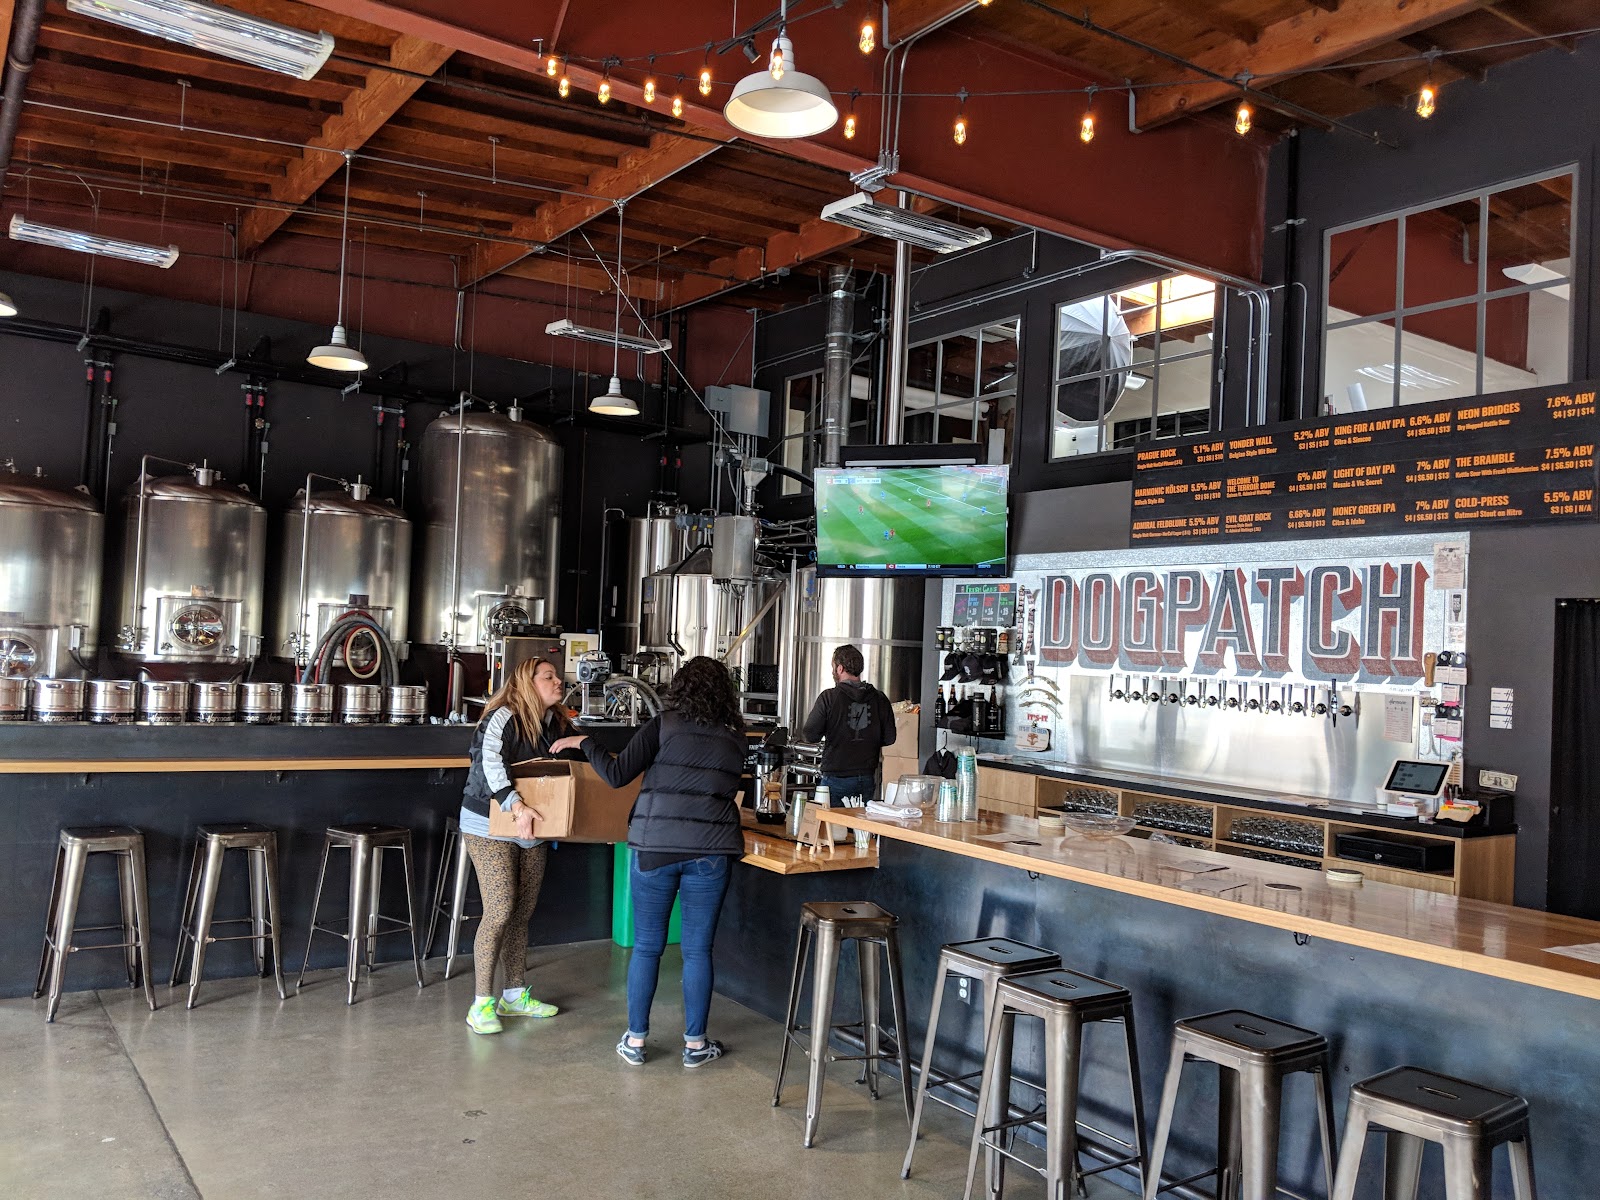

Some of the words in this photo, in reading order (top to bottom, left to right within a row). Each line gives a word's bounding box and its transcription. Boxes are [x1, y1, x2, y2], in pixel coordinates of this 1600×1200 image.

[1547, 396, 1572, 408] 7.6%
[1575, 392, 1595, 404] ABV
[1458, 408, 1480, 420] NEON
[1482, 403, 1520, 417] BRIDGES
[1553, 411, 1562, 419] $4
[1581, 407, 1595, 416] $14
[1410, 417, 1431, 426] 6.6%
[1434, 413, 1451, 423] ABV
[1334, 426, 1352, 436] KING
[1353, 423, 1368, 433] FOR
[1369, 422, 1375, 432] A
[1376, 420, 1391, 431] DAY
[1392, 418, 1405, 428] IPA
[1418, 428, 1434, 436] $6.50
[1294, 431, 1313, 440] 5.2%
[1315, 428, 1330, 438] ABV
[1193, 445, 1210, 454] 5.1%
[1211, 442, 1224, 451] ABV
[1229, 438, 1254, 449] YONDER
[1256, 436, 1273, 446] WALL
[1137, 452, 1159, 461] PRAGUE
[1160, 449, 1177, 458] ROCK
[1229, 451, 1245, 459] Belgian
[1546, 448, 1571, 459] 7.5%
[1573, 445, 1594, 457] ABV
[1417, 461, 1431, 471] 7%
[1433, 459, 1450, 470] ABV
[1456, 457, 1472, 468] THE
[1474, 453, 1515, 466] BRAMBLE
[1541, 463, 1551, 471] $4
[1556, 461, 1574, 470] $6.50
[1579, 460, 1593, 468] $13
[1297, 473, 1310, 481] 6%
[1312, 470, 1327, 480] ABV
[1333, 468, 1354, 479] LIGHT
[1356, 467, 1365, 476] OF
[1366, 466, 1381, 476] DAY
[1383, 464, 1395, 474] IPA
[1191, 483, 1207, 492] 5.5%
[1209, 481, 1222, 490] ABV
[1227, 477, 1251, 485] WELCOME
[1135, 487, 1164, 497] HARMONIC
[1165, 484, 1188, 494] KÖLSCH
[1544, 492, 1570, 503] 5.5%
[1572, 490, 1592, 501] ABV
[1415, 501, 1430, 511] 7%
[1432, 500, 1449, 510] ABV
[1456, 495, 1509, 508] COLD-PRESS
[1289, 510, 1311, 519] 6.66%
[1312, 508, 1326, 517] ABV
[1333, 506, 1357, 516] MONEY
[1358, 504, 1382, 515] GREEN
[1383, 503, 1396, 513] IPA
[1551, 506, 1559, 514] $3
[1564, 505, 1573, 513] $6
[1189, 518, 1206, 526] 5.5%
[1207, 516, 1220, 525] ABV
[1239, 514, 1254, 522] GOAT
[1255, 513, 1272, 521] BOCK
[1417, 513, 1433, 521] $6.50
[1133, 521, 1156, 530] ADMIRAL
[1157, 519, 1187, 528] FELDBLUME
[1040, 562, 1428, 682] DOGPATCH
